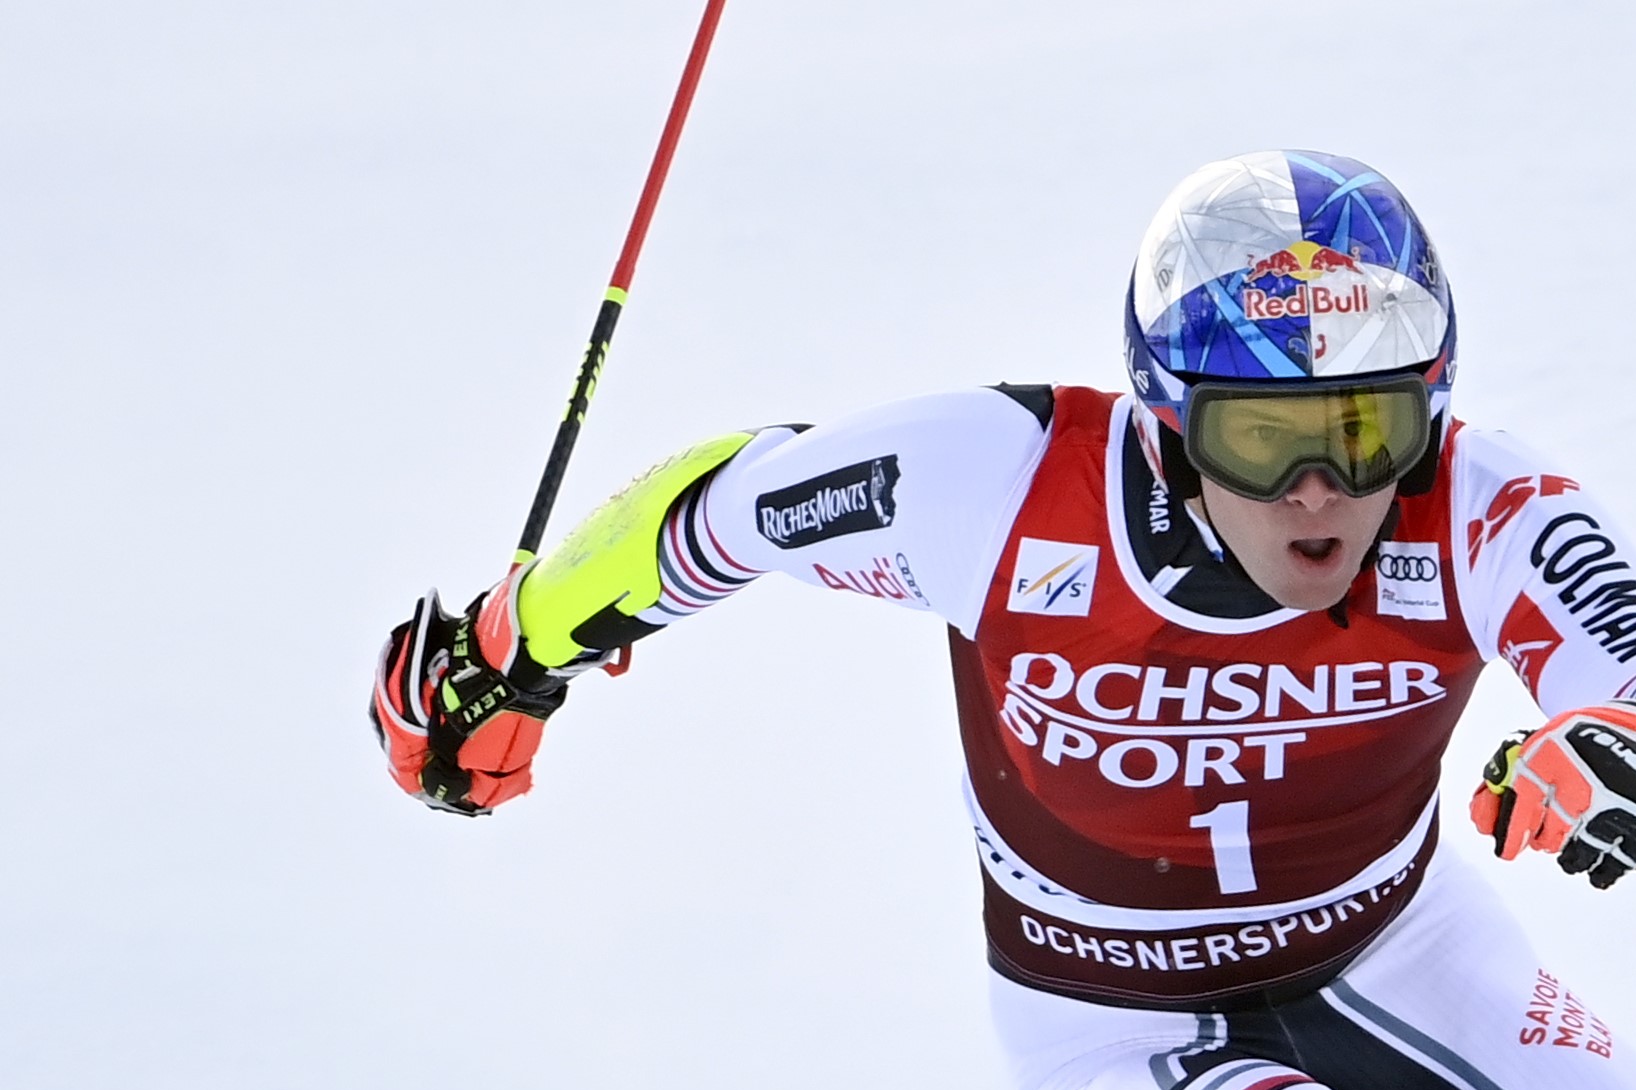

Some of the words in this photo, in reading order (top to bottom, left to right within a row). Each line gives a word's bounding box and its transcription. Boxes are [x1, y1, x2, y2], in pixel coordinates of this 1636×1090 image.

[1244, 283, 1308, 320] Red
[1311, 283, 1369, 315] Bull
[1149, 482, 1170, 534] MAR
[813, 557, 916, 600] Audi
[1017, 578, 1085, 598] FIS
[463, 684, 507, 724] LEKI
[1009, 652, 1447, 721] OCHSNER
[1000, 692, 1307, 788] SPORT
[1189, 800, 1258, 895] 1
[1519, 968, 1558, 1045] SAVOIE
[1552, 991, 1586, 1048] MONT
